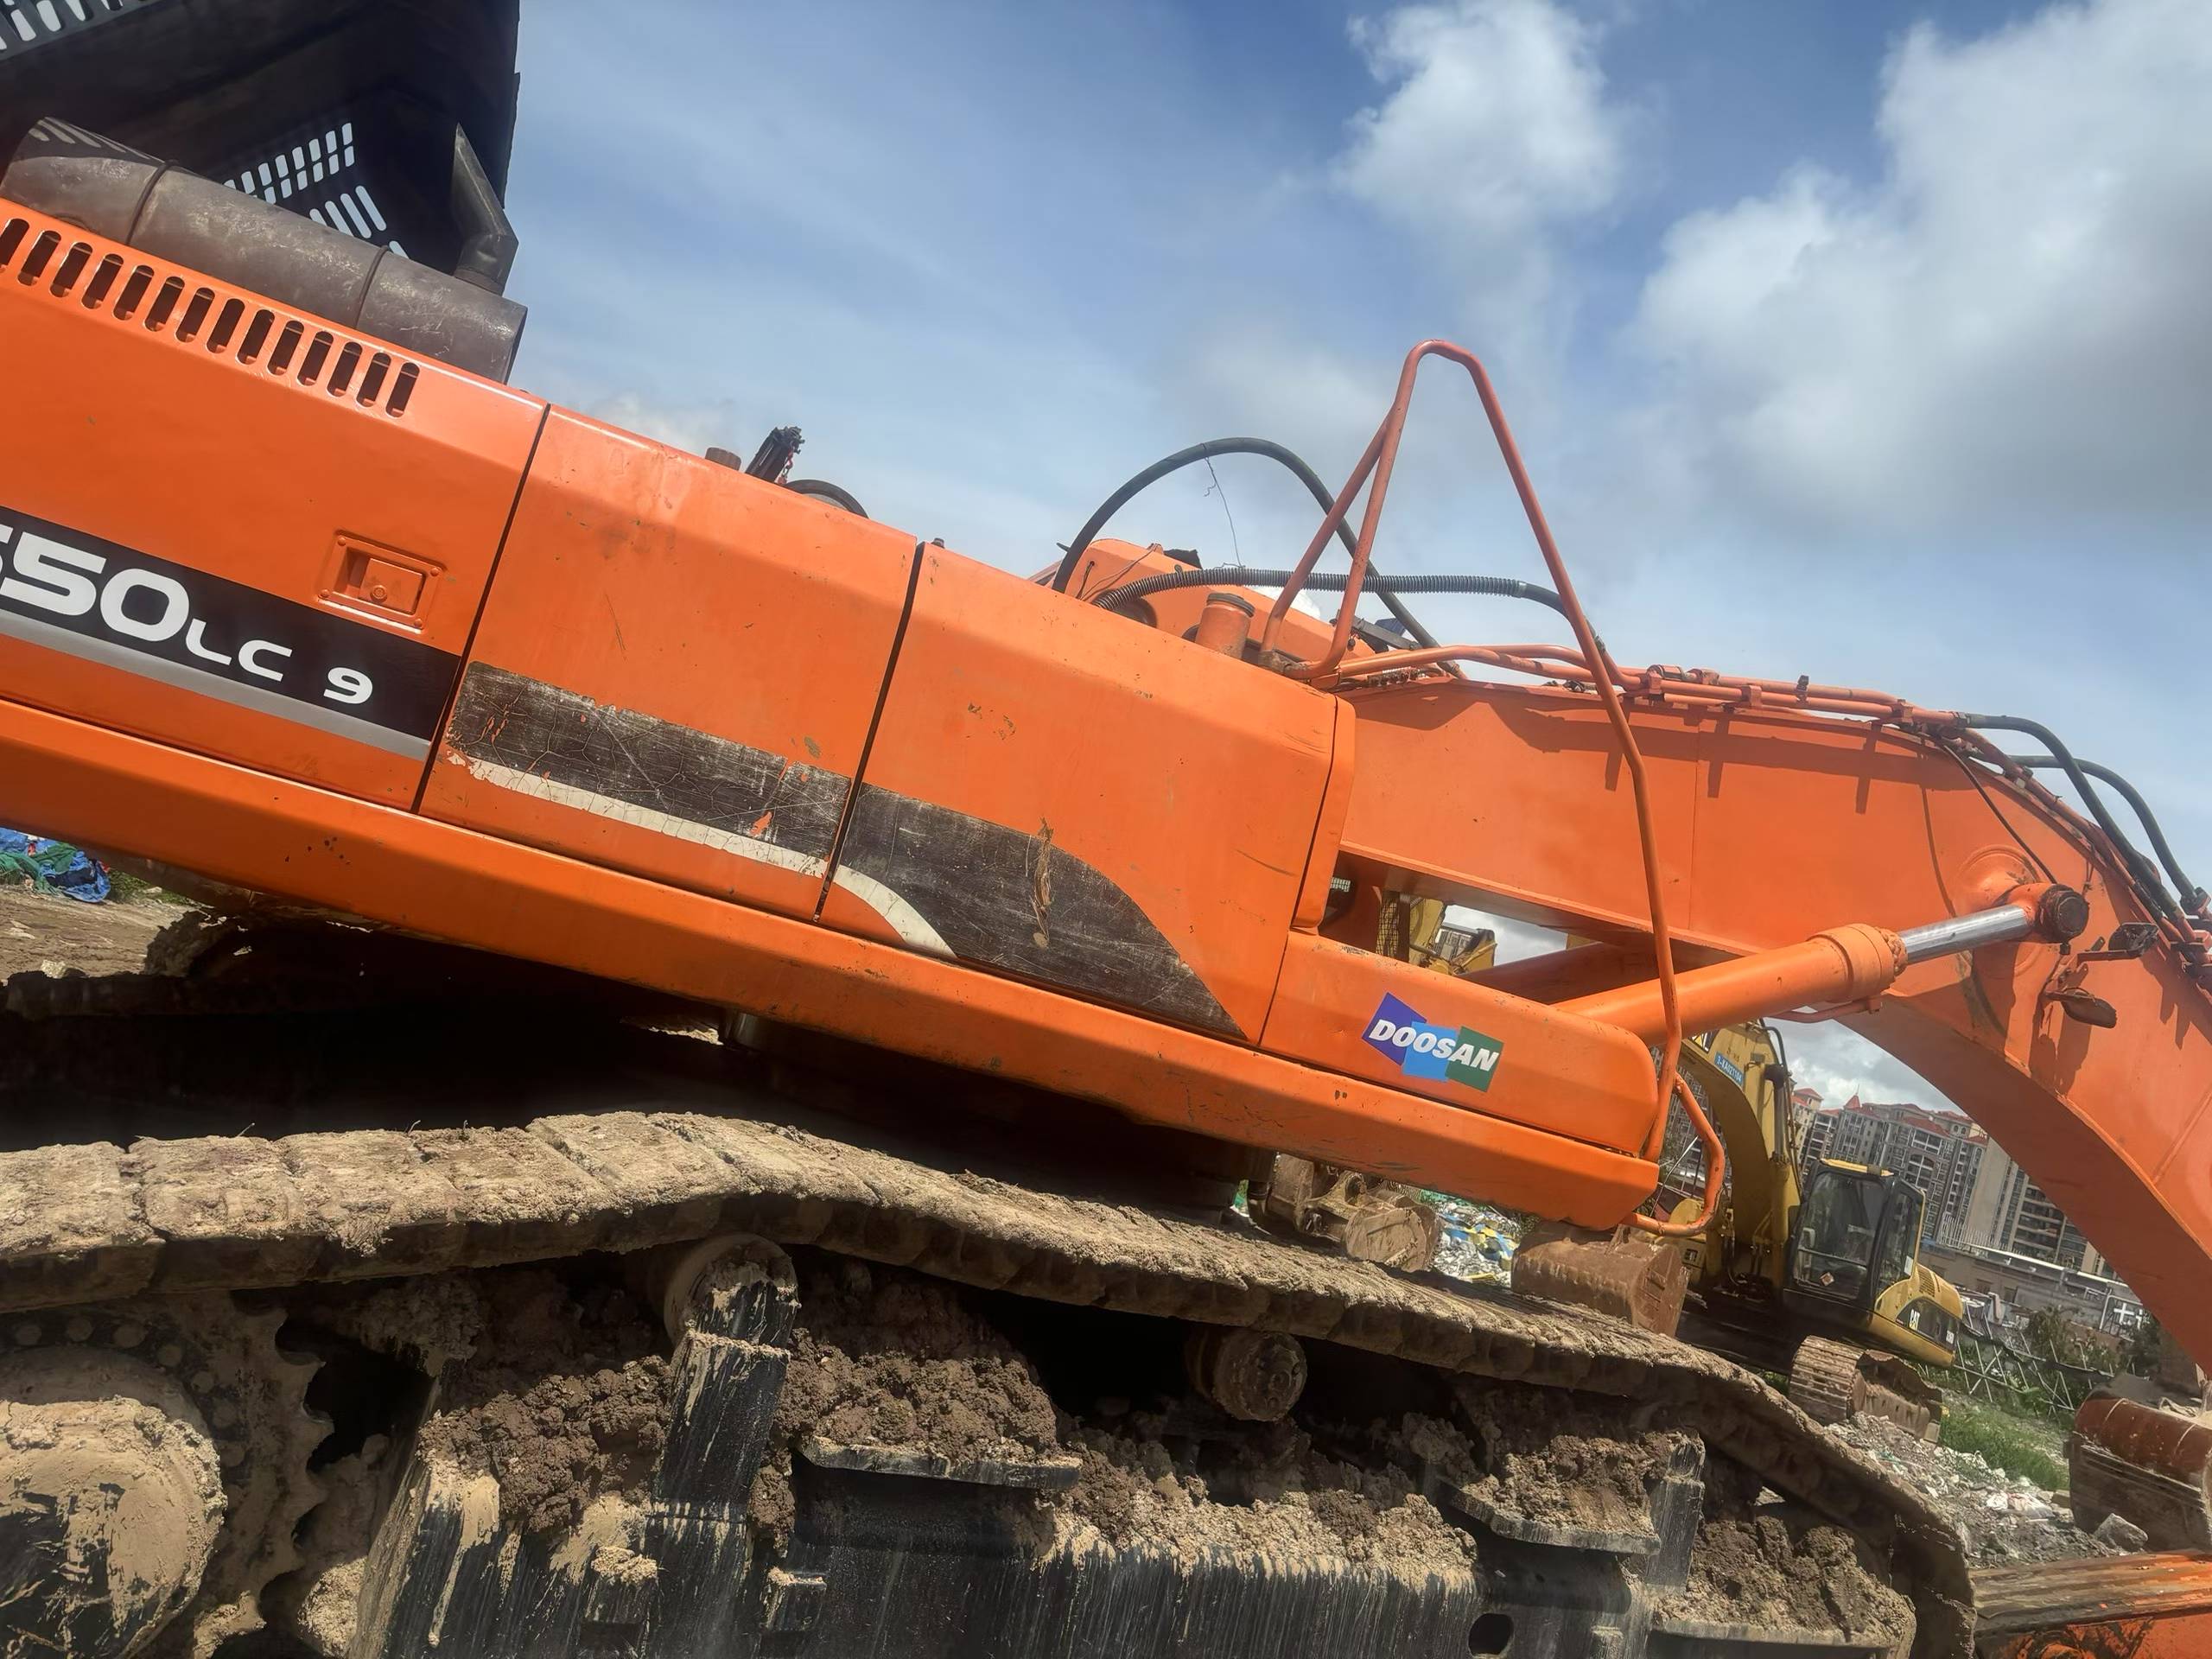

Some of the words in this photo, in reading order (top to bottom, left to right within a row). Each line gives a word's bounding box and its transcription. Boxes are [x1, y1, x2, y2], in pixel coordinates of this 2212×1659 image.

[323, 667, 373, 704] 9
[1369, 1019, 1499, 1071] DOOSAN
[1909, 1308, 1920, 1331] CAT
